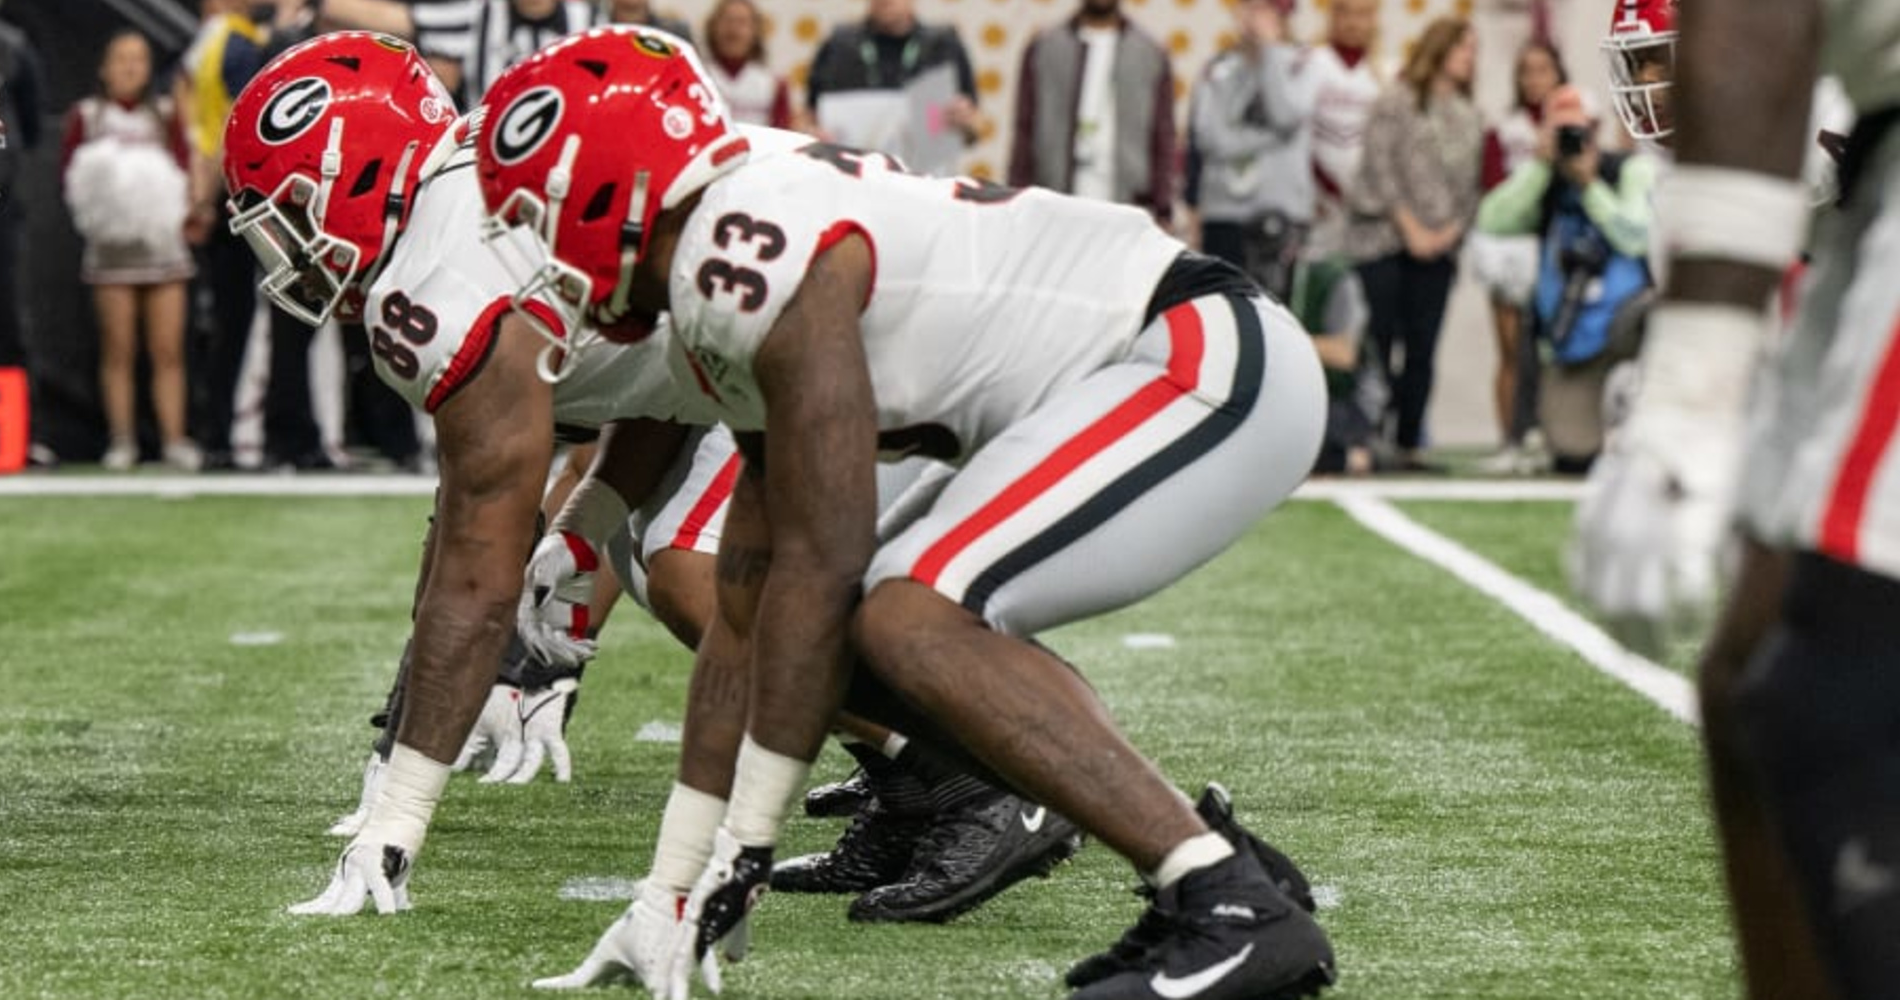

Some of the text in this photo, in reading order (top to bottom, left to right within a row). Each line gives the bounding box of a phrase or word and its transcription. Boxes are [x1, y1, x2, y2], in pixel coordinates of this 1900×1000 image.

[259, 79, 330, 143] G
[493, 87, 563, 163] G
[696, 212, 788, 314] 33
[370, 289, 438, 382] 88
